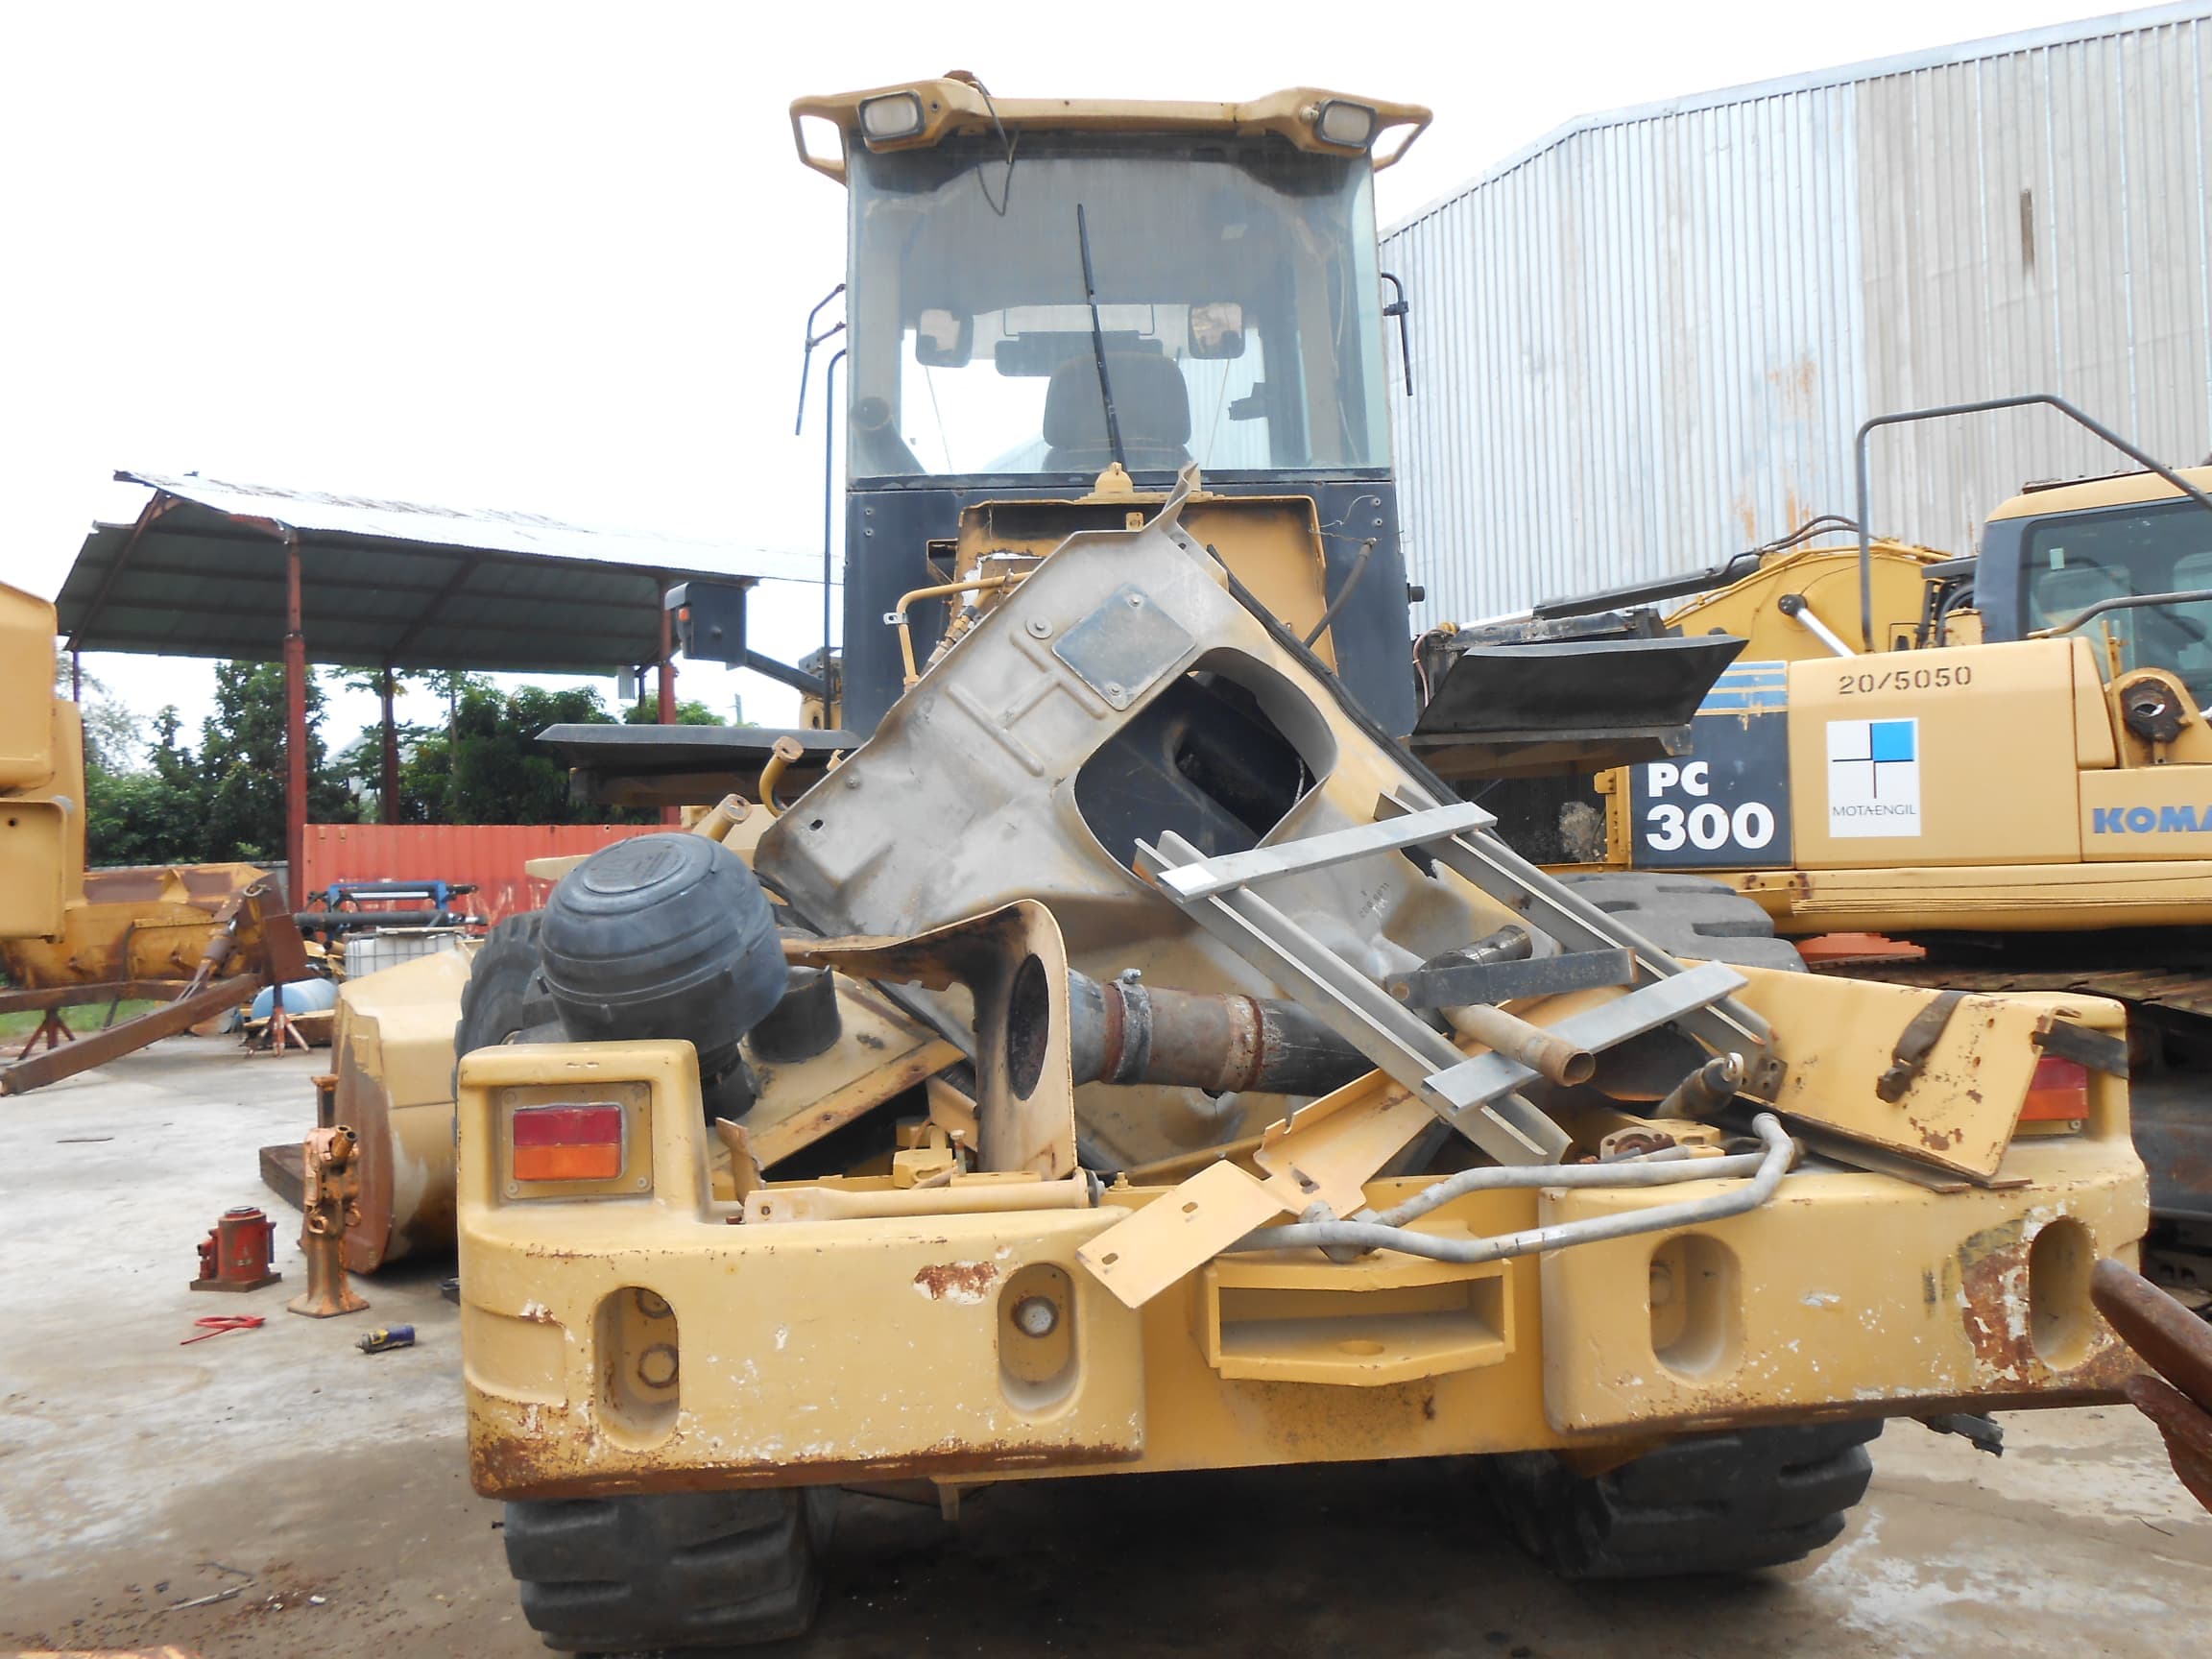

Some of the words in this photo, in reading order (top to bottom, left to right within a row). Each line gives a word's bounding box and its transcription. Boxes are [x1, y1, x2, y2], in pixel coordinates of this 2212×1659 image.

[1839, 666, 1972, 695] 20/5050
[1647, 760, 1709, 798] PC
[1646, 802, 1775, 852] 300
